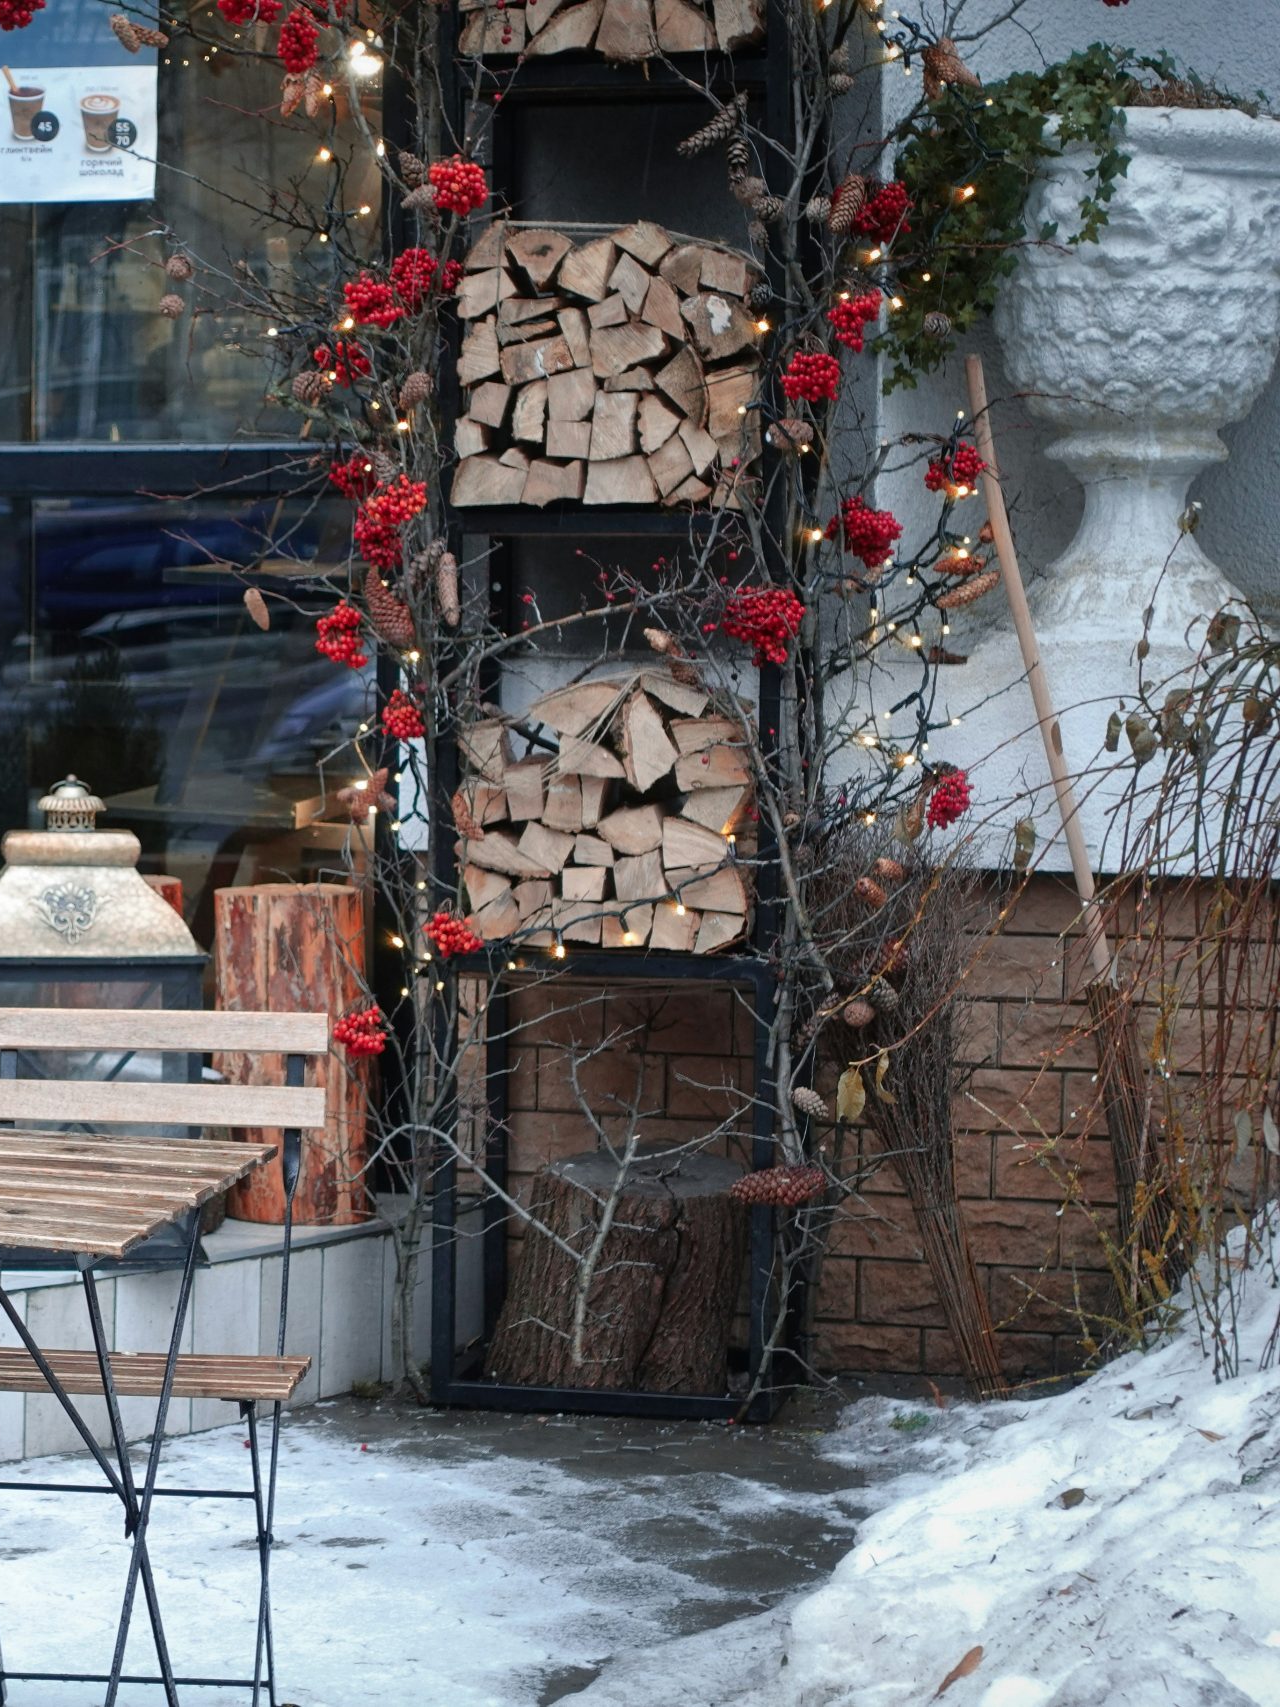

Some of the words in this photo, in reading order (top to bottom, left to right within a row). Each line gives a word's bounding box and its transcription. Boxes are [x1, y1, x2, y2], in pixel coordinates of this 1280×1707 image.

[37, 121, 53, 132] 45
[115, 122, 130, 132] 55
[116, 135, 130, 146] 70
